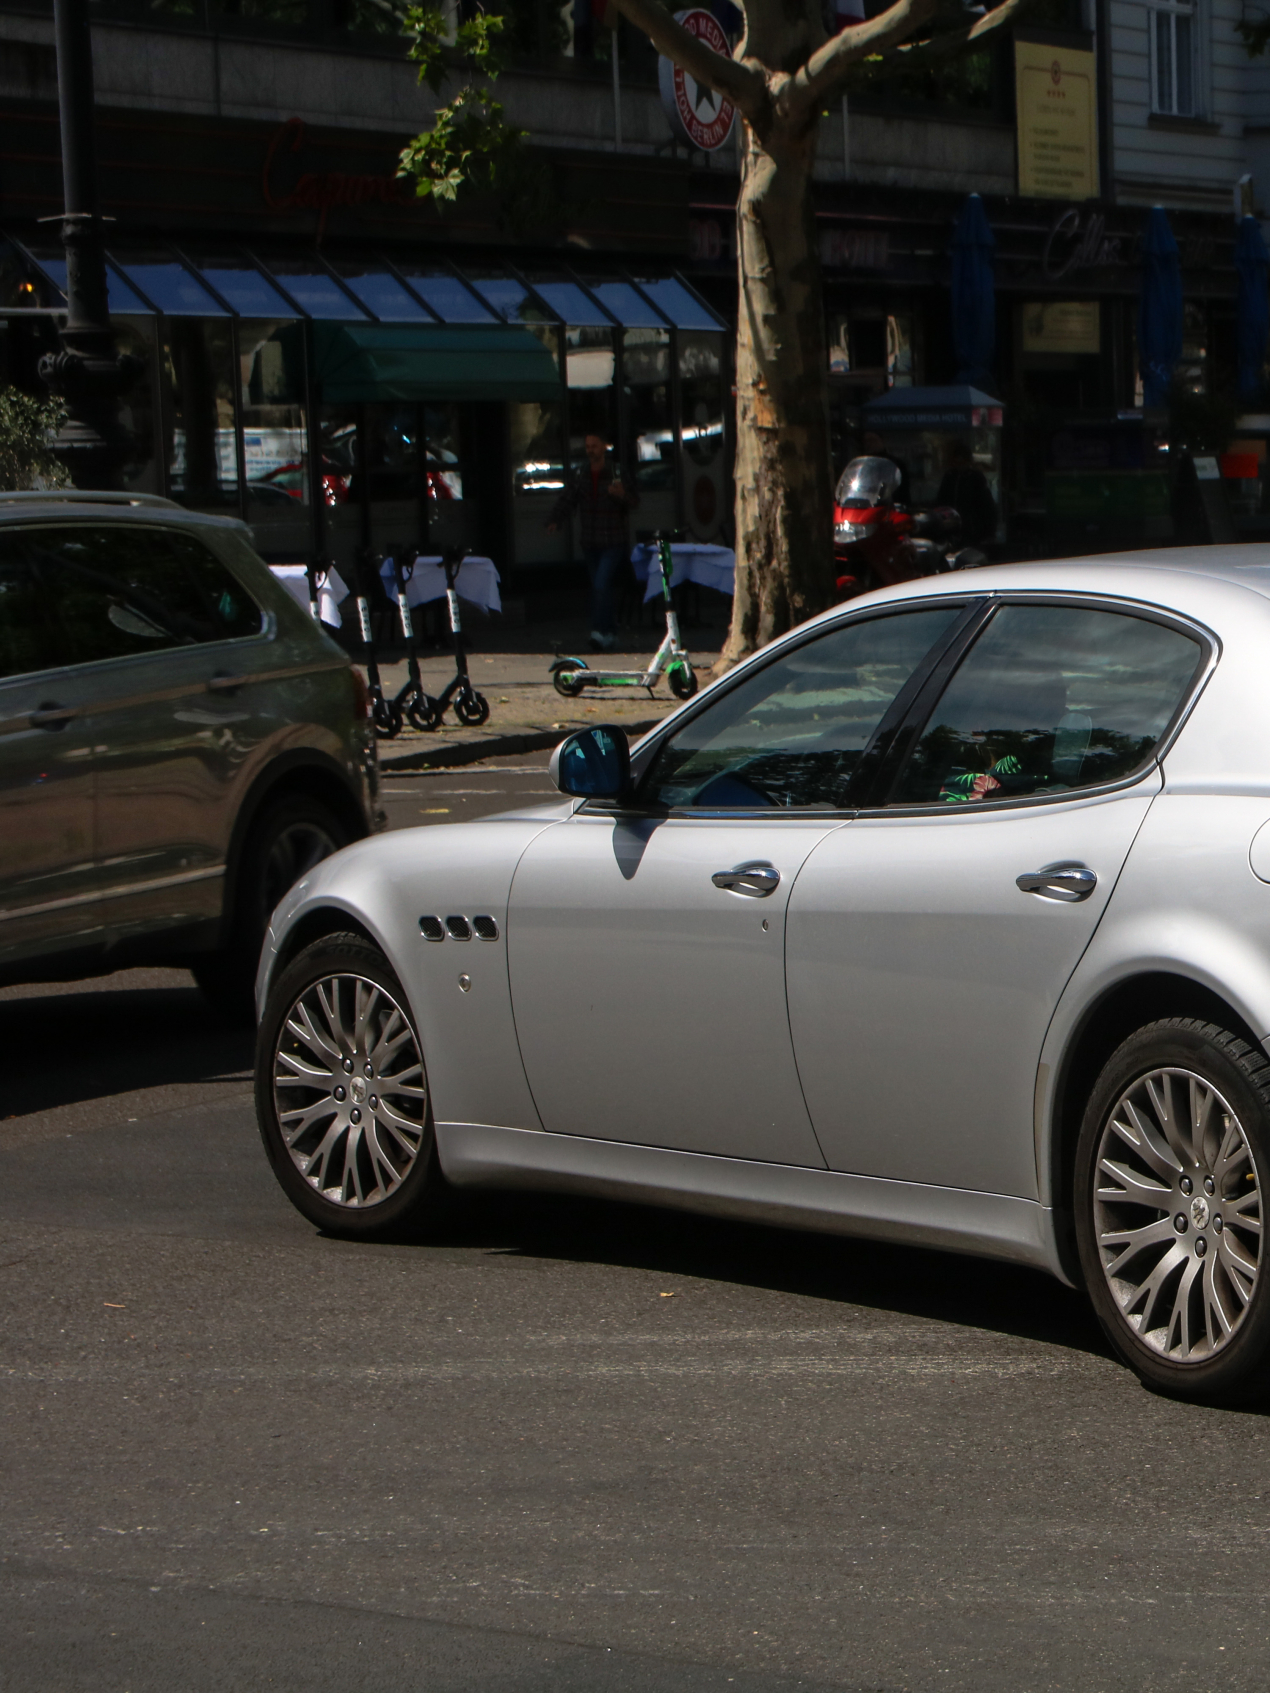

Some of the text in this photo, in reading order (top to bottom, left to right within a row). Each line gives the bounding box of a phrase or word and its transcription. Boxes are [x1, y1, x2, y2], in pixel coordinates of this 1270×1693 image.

[691, 119, 723, 145] BERLIN
[867, 414, 967, 423] HOLLYWOOD MEDIA HOTEL
